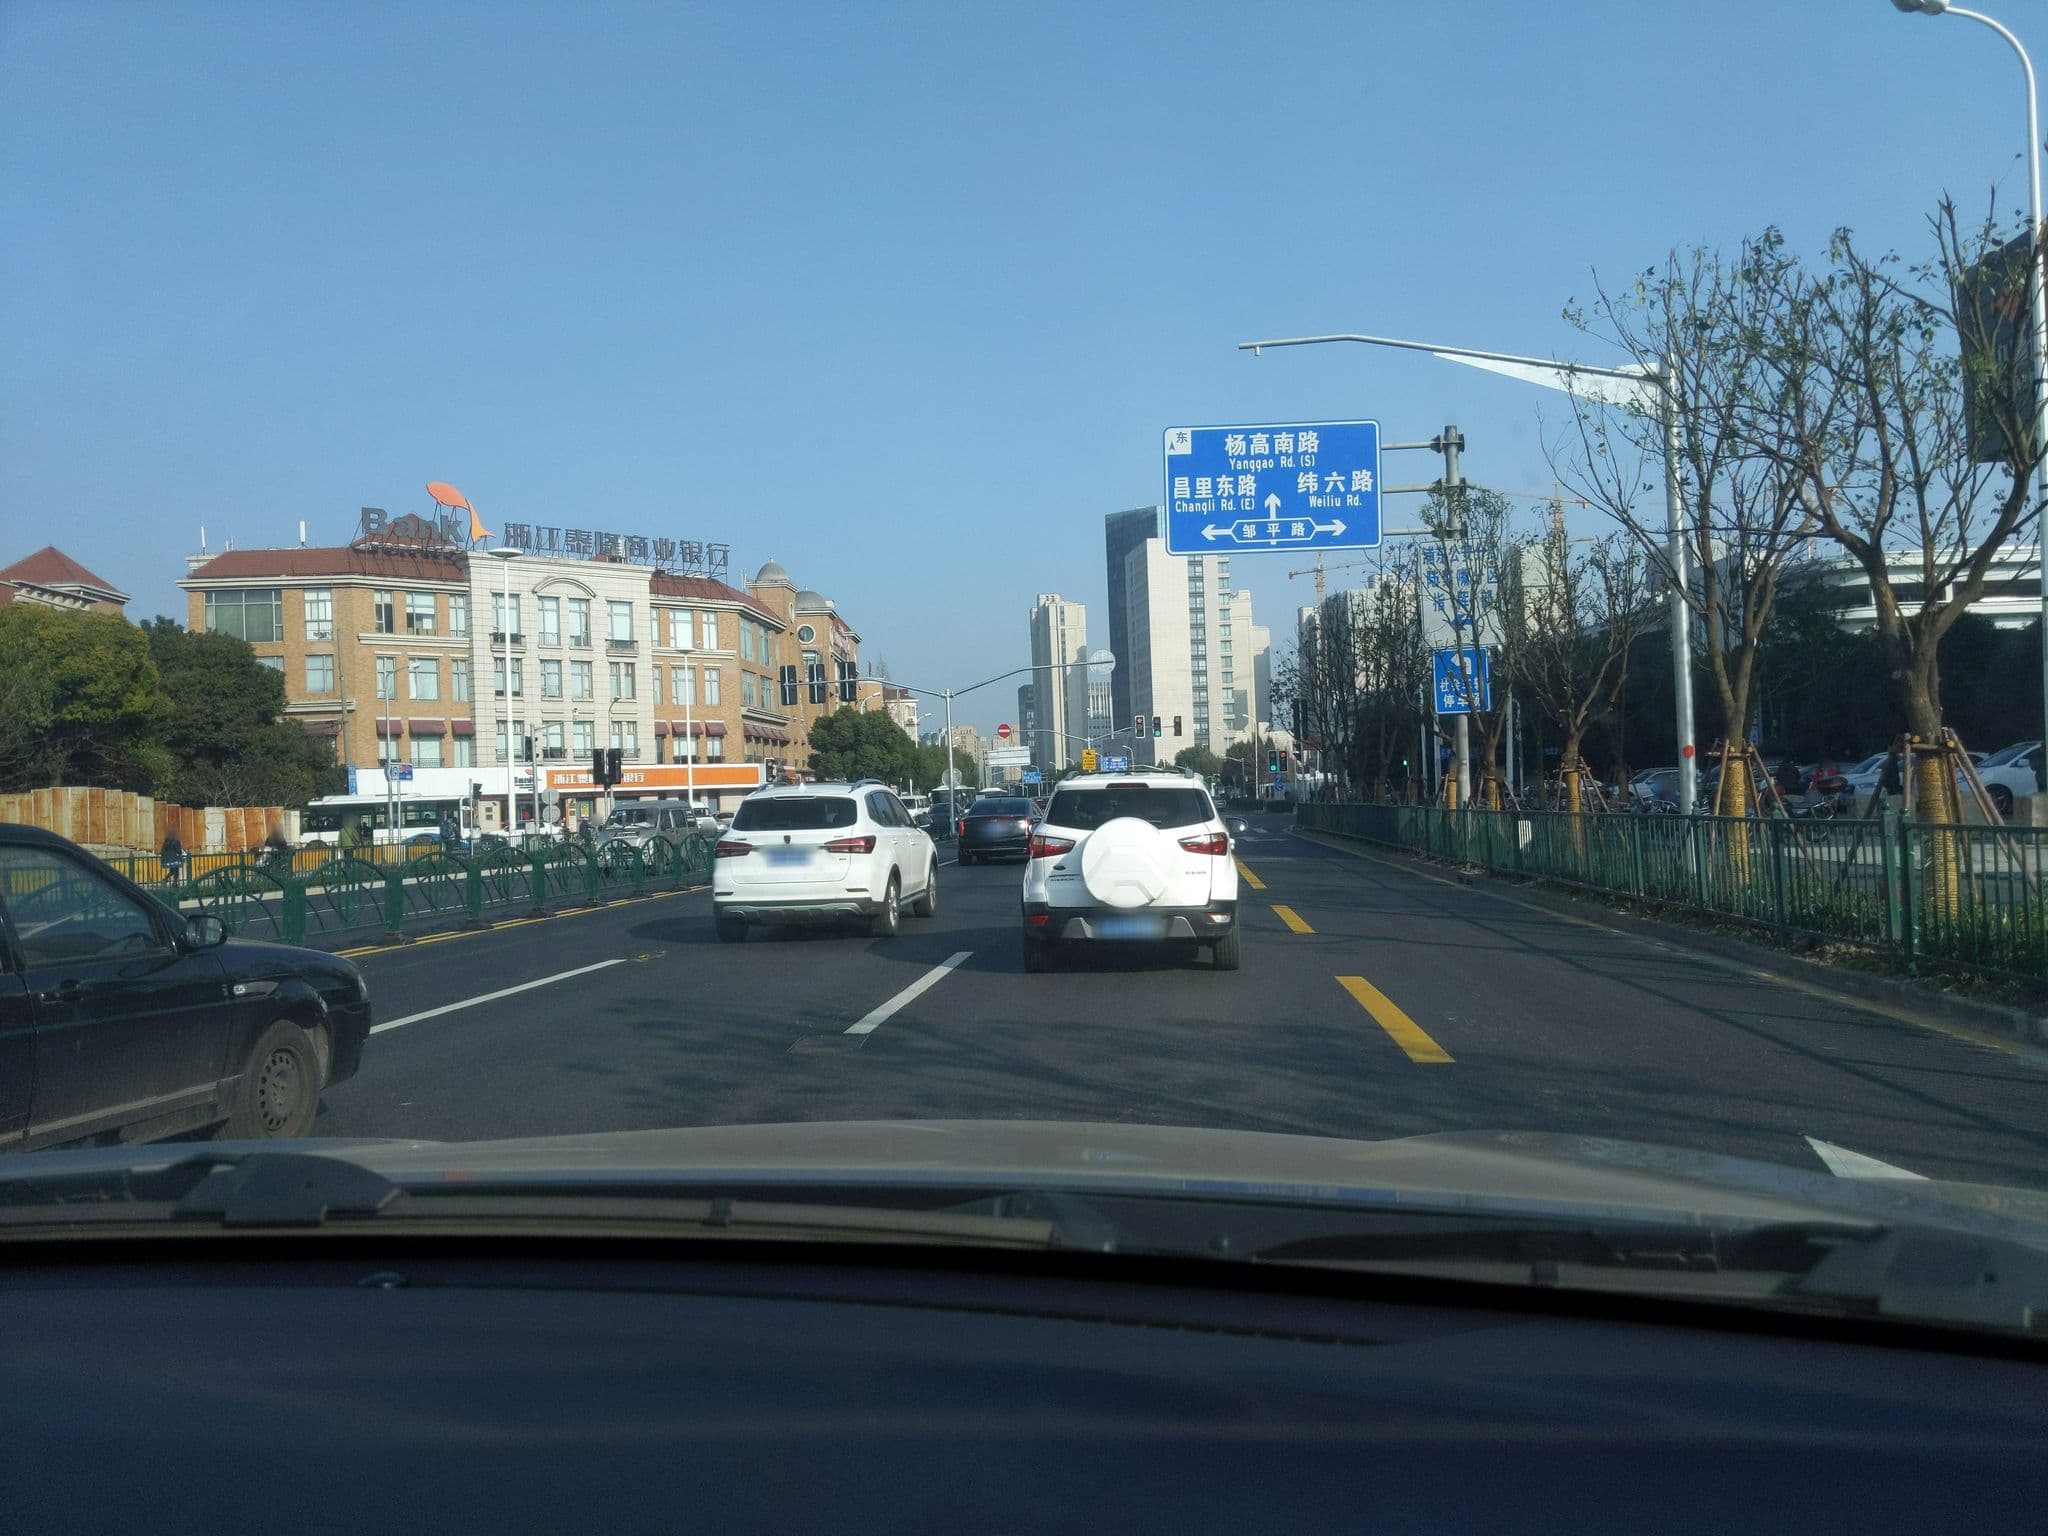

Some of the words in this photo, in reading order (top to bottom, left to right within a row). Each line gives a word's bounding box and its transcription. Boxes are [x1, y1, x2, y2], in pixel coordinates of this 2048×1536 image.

[1175, 431, 1188, 444] 东
[1224, 430, 1320, 457] 杨高南路
[1229, 457, 1275, 473] Yanggao
[1280, 456, 1296, 468] Rd.
[1300, 455, 1316, 467] (S)
[1173, 474, 1258, 500] 昌里东路
[1297, 469, 1374, 495] 纬六路
[1175, 498, 1216, 515] Changli
[1221, 498, 1236, 511] Rd.
[1241, 498, 1256, 511] (E)
[1308, 495, 1341, 508] Weiliu
[1346, 495, 1362, 507] Rd.
[361, 506, 465, 543] Bank
[1242, 521, 1306, 539] 邹平路
[504, 522, 730, 567] 浙江泰隆商业银行
